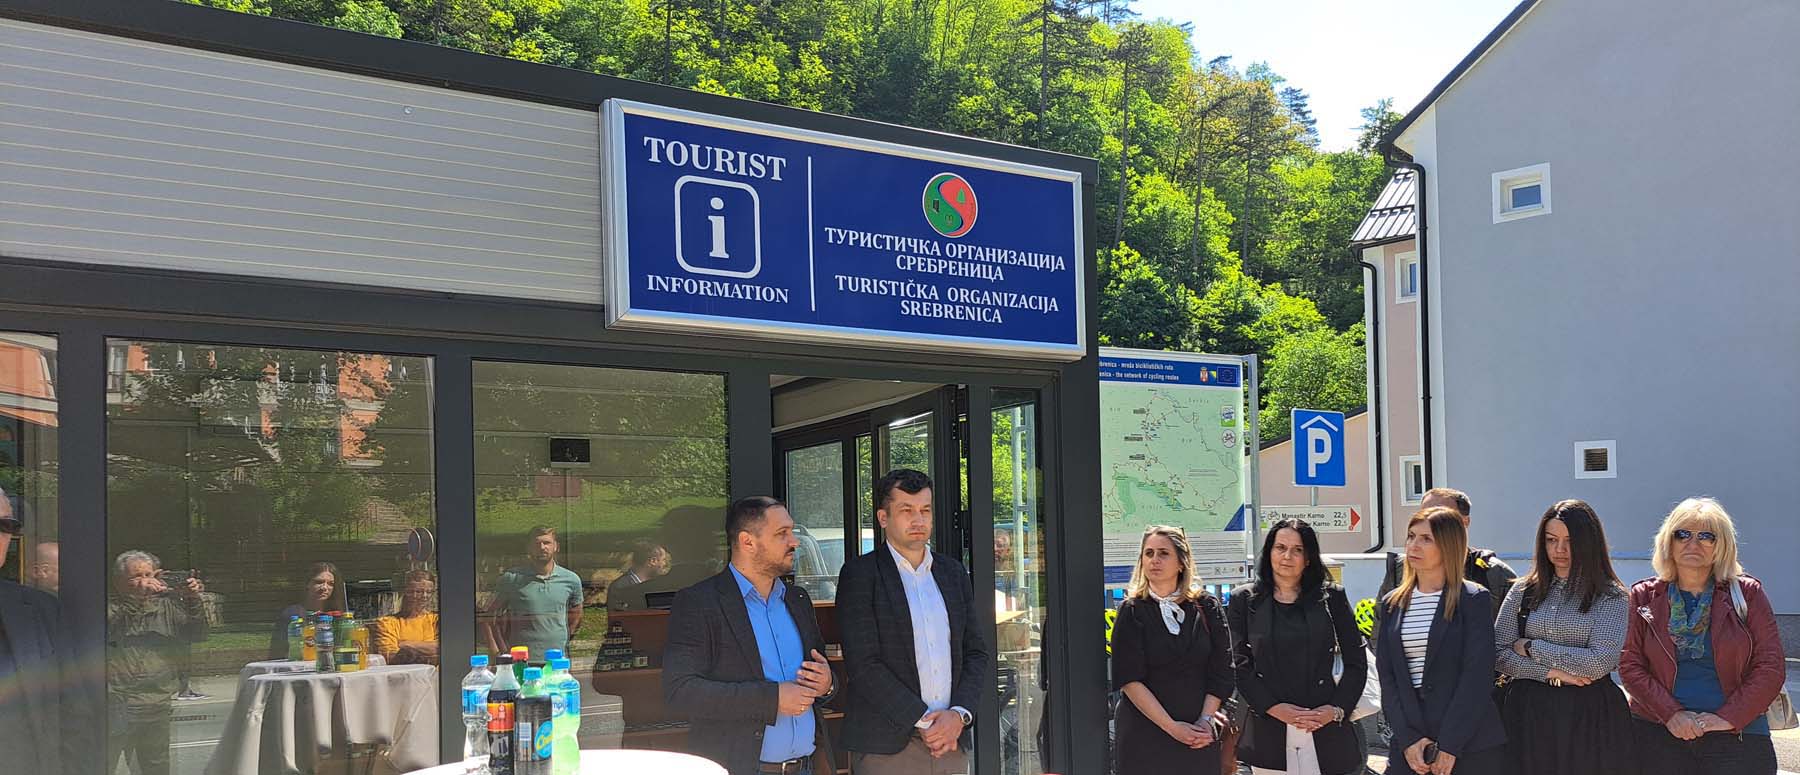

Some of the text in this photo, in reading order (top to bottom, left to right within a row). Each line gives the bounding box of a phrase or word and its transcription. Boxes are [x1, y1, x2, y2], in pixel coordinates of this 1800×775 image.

[643, 136, 787, 181] TOURIST
[708, 197, 729, 259] i
[825, 227, 1065, 272] ТУРИСТИЧКА ОРГАНИЗАЦИЈА
[896, 254, 1004, 283] СРЕБРЕНИЦА
[647, 274, 789, 303] INFORMATION
[835, 275, 1059, 314] TURISTIČKA ORGANIZACIJA
[900, 299, 1002, 323] SREBRENICA
[1148, 373, 1164, 381] cycling
[1307, 427, 1332, 477] P
